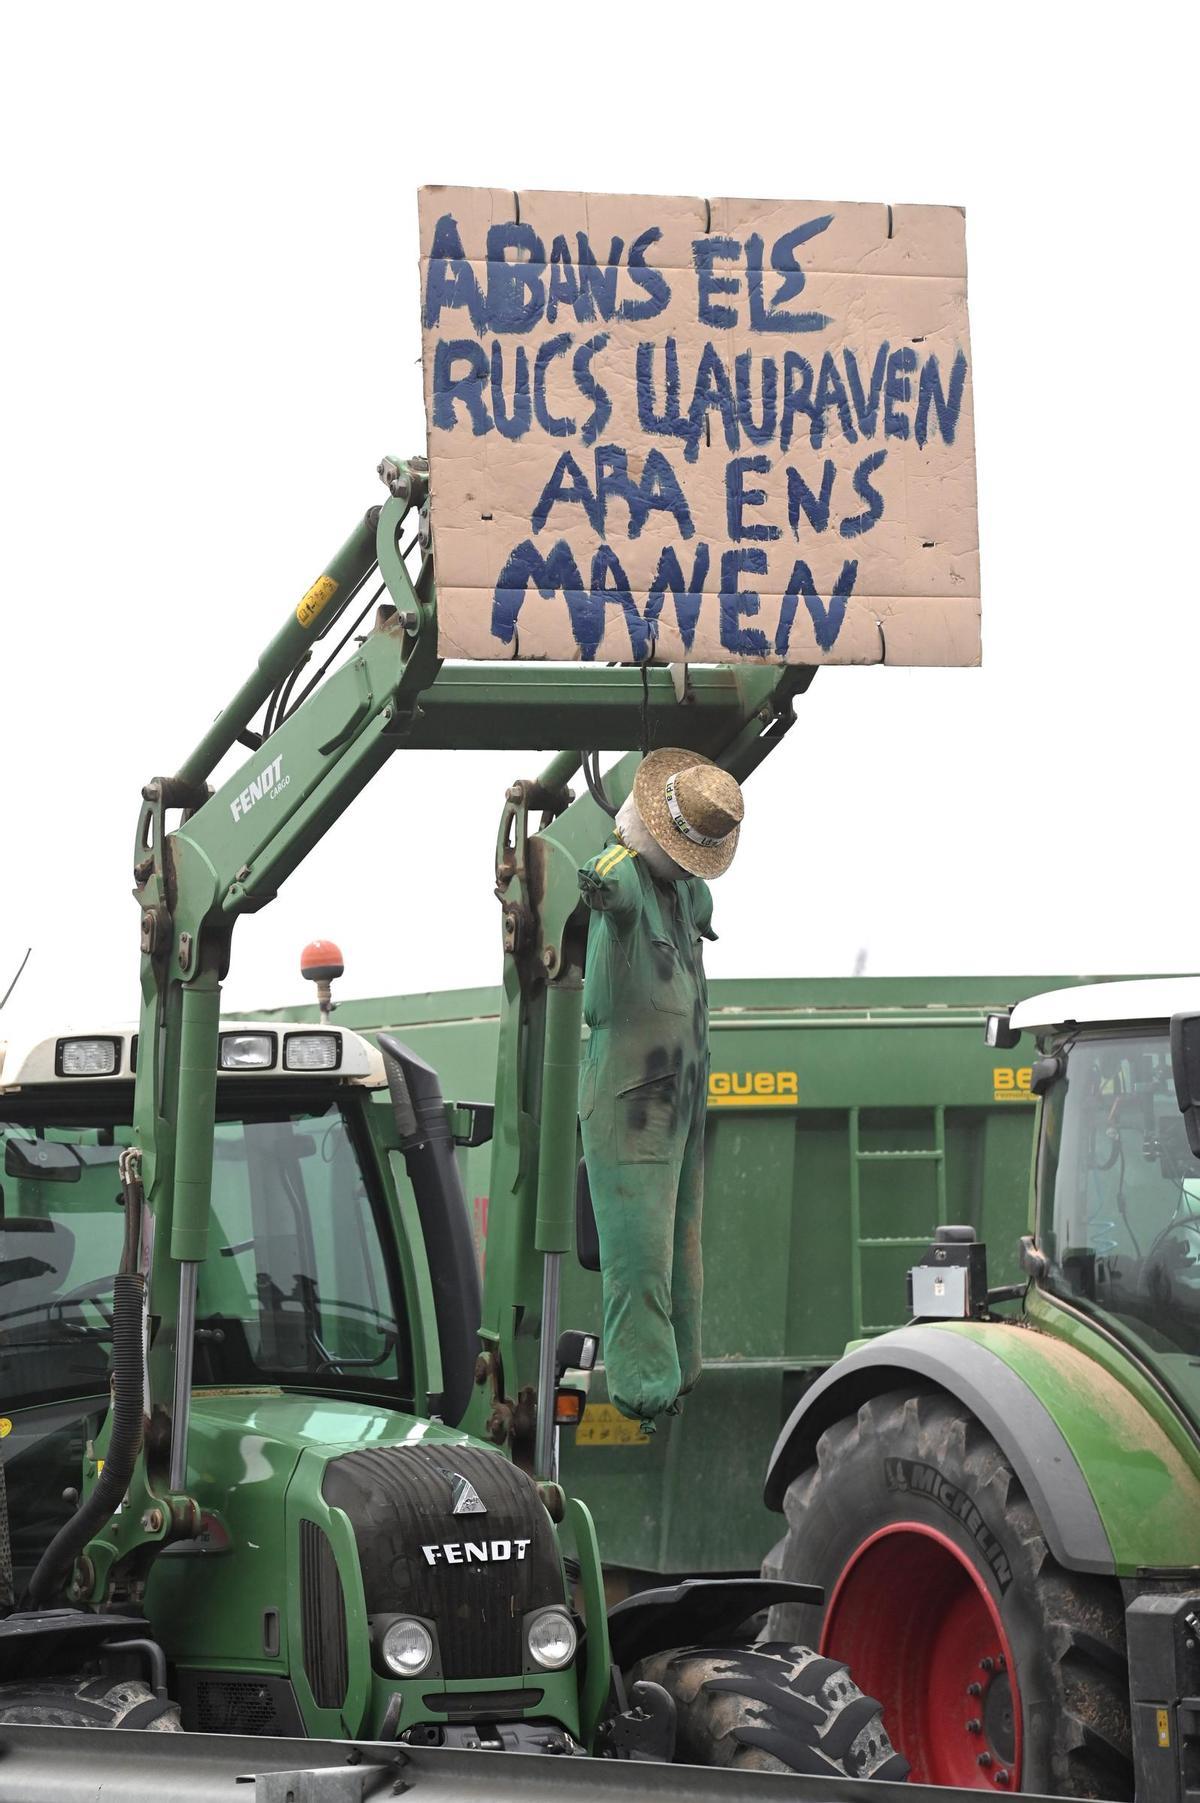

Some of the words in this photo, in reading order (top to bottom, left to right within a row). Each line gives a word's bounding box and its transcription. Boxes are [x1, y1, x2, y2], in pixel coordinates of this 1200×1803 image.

[424, 212, 672, 337] ABANS
[692, 214, 836, 333] ELS
[432, 333, 613, 447] RUCS
[531, 444, 696, 541] ARA
[724, 449, 889, 541] ENS
[490, 539, 858, 662] MANEN
[230, 754, 283, 822] FENDT
[270, 775, 291, 799] CARGO
[421, 1540, 531, 1566] FENDT
[911, 1464, 1013, 1586] MICHELIN
